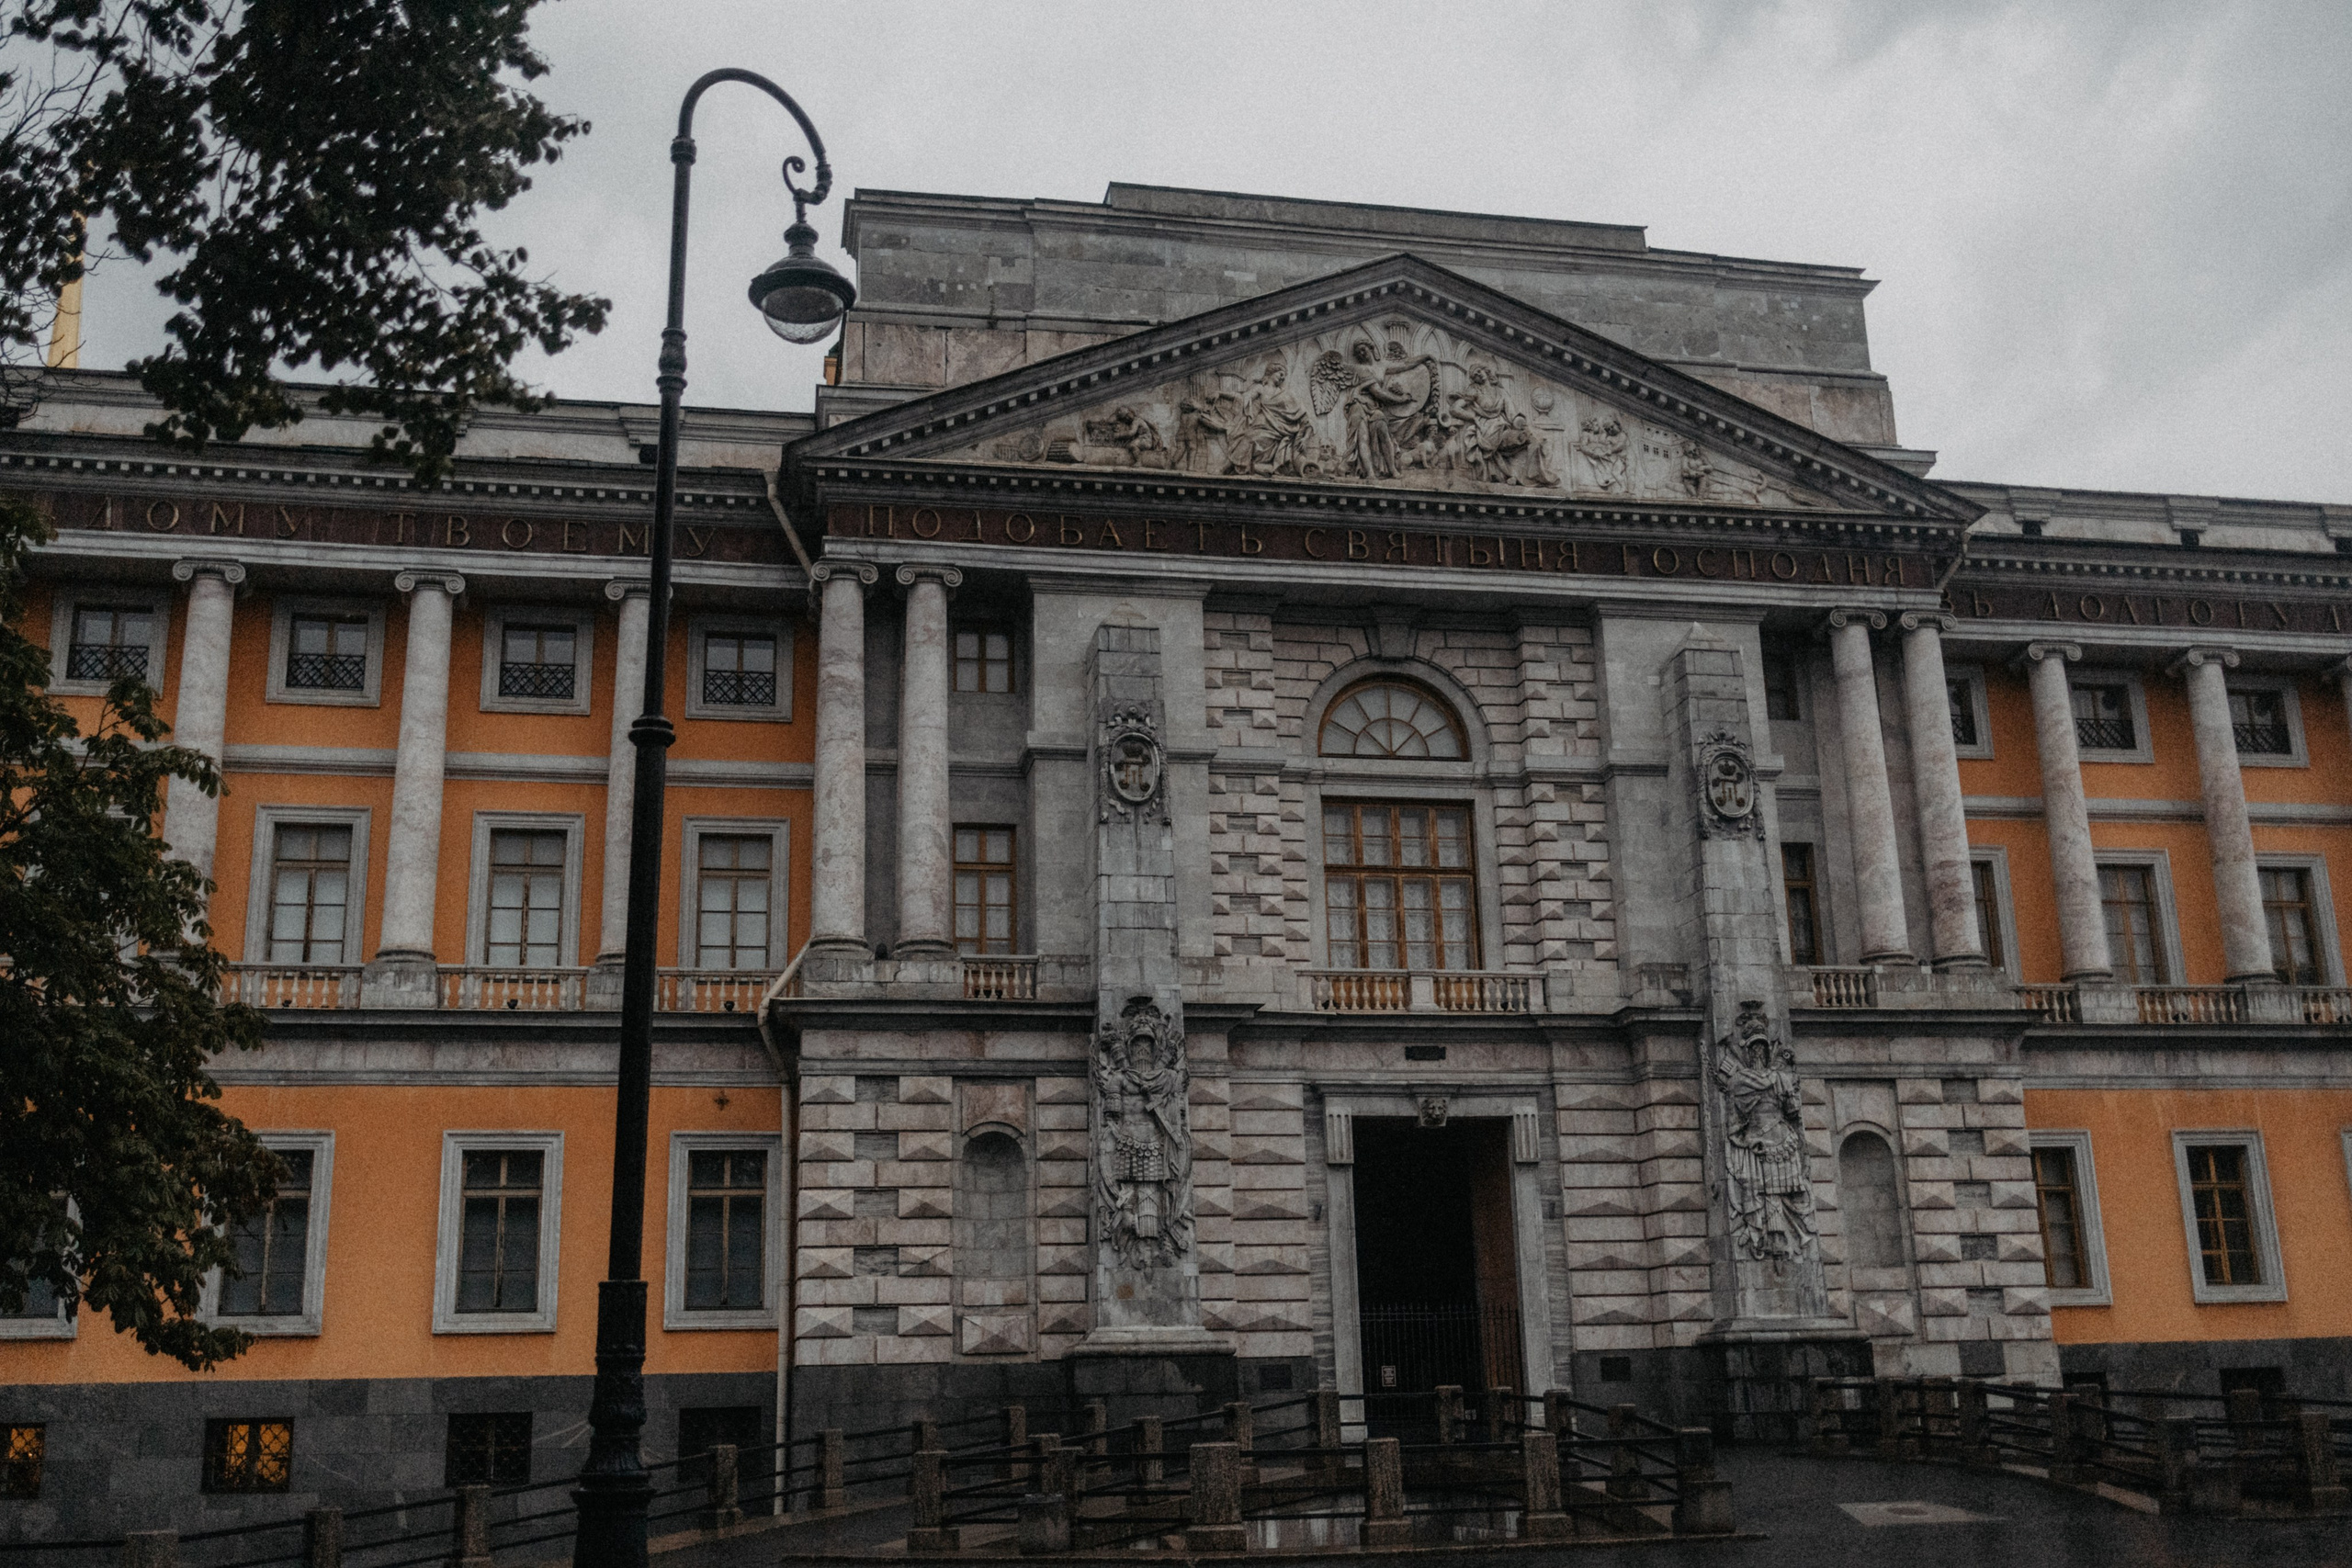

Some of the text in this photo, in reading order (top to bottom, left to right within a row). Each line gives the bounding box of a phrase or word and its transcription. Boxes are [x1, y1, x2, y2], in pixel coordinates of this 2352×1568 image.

[86, 495, 308, 537] ДОМУ
[386, 512, 716, 558] ТВОЕМУ
[1304, 528, 1578, 570] СВЯТЫНЯ
[1622, 544, 1905, 585] ГОСПОДНЯ
